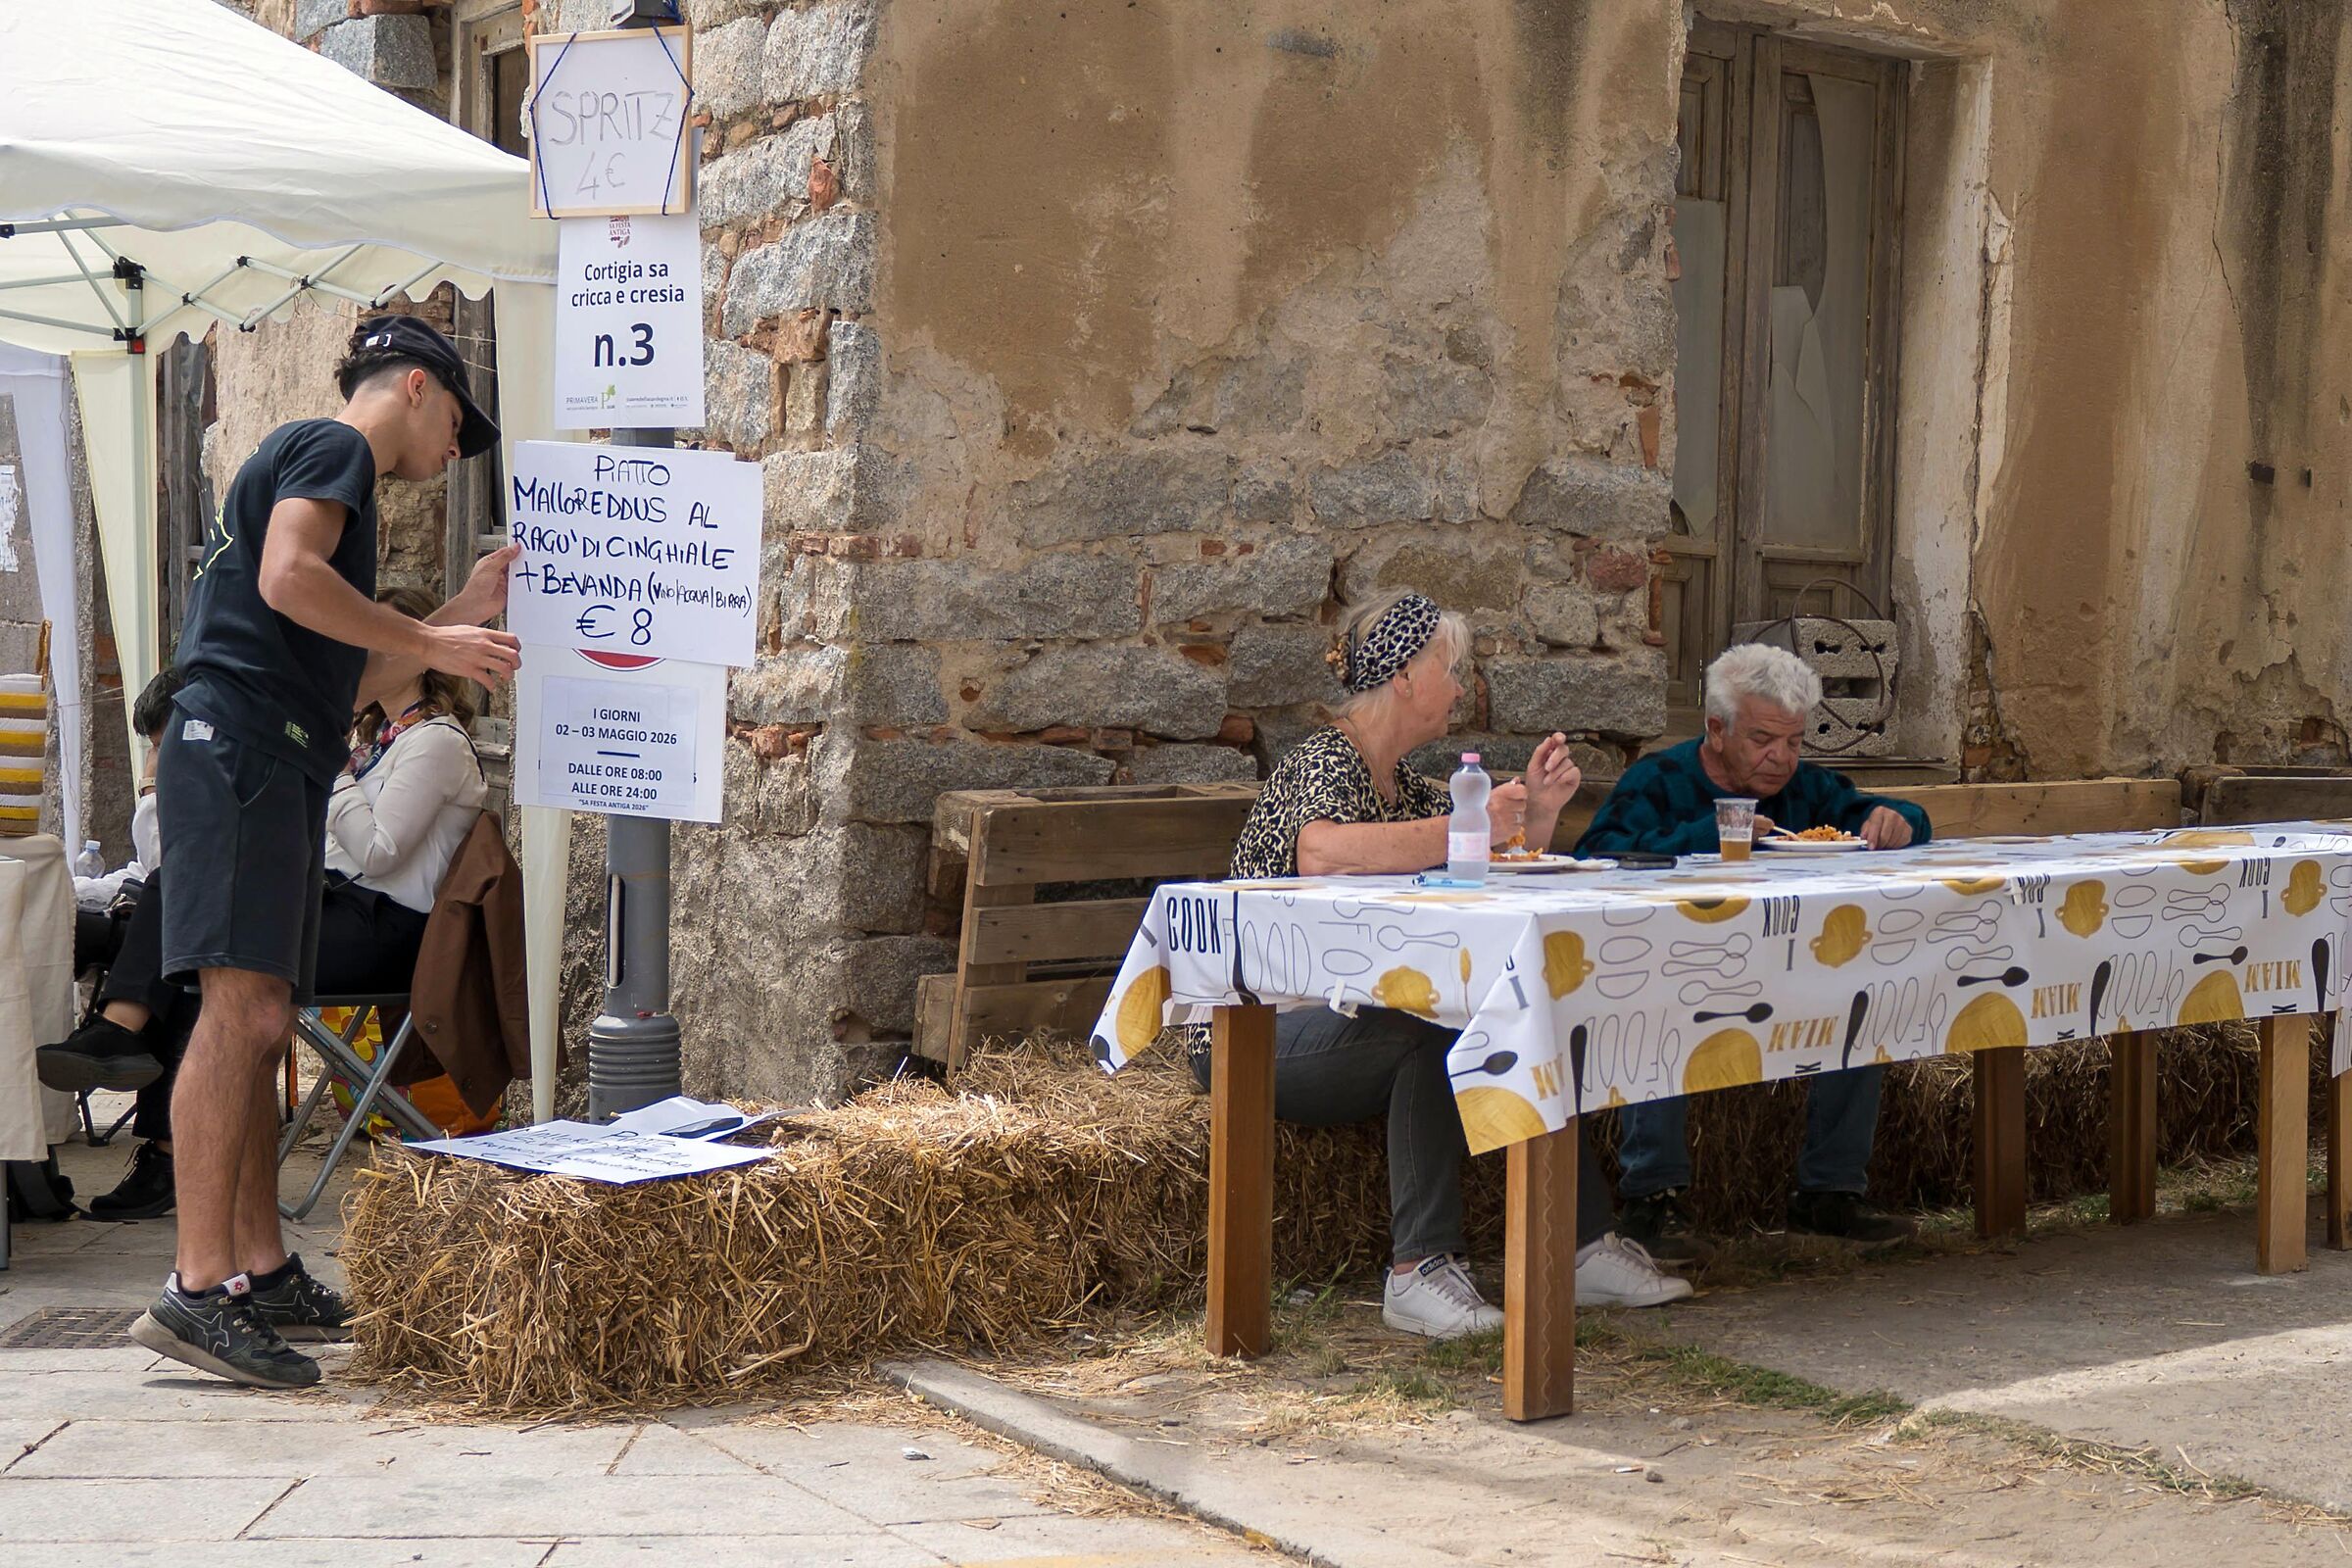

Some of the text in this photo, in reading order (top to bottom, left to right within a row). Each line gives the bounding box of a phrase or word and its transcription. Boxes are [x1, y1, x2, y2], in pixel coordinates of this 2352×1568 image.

[549, 90, 674, 146] SPRITZ
[584, 261, 668, 283] Cortigia sa
[571, 283, 685, 307] cricca e cresia
[594, 322, 656, 368] n.3
[688, 502, 718, 529] AL
[541, 564, 642, 602] BEVANDA
[575, 605, 653, 646] € 8
[593, 708, 641, 722] I GIORNI
[556, 724, 569, 736] 02
[581, 726, 595, 738] 03
[598, 727, 648, 742] MAGGIO
[650, 731, 677, 745] 2026
[568, 762, 662, 781] DALLE ORE 08:00
[571, 782, 658, 800] ALLE ORE 24:00
[590, 800, 607, 808] FESTA
[608, 802, 630, 810] ANTIGA
[1166, 897, 1221, 954] COOK
[1763, 895, 1800, 938] COOK
